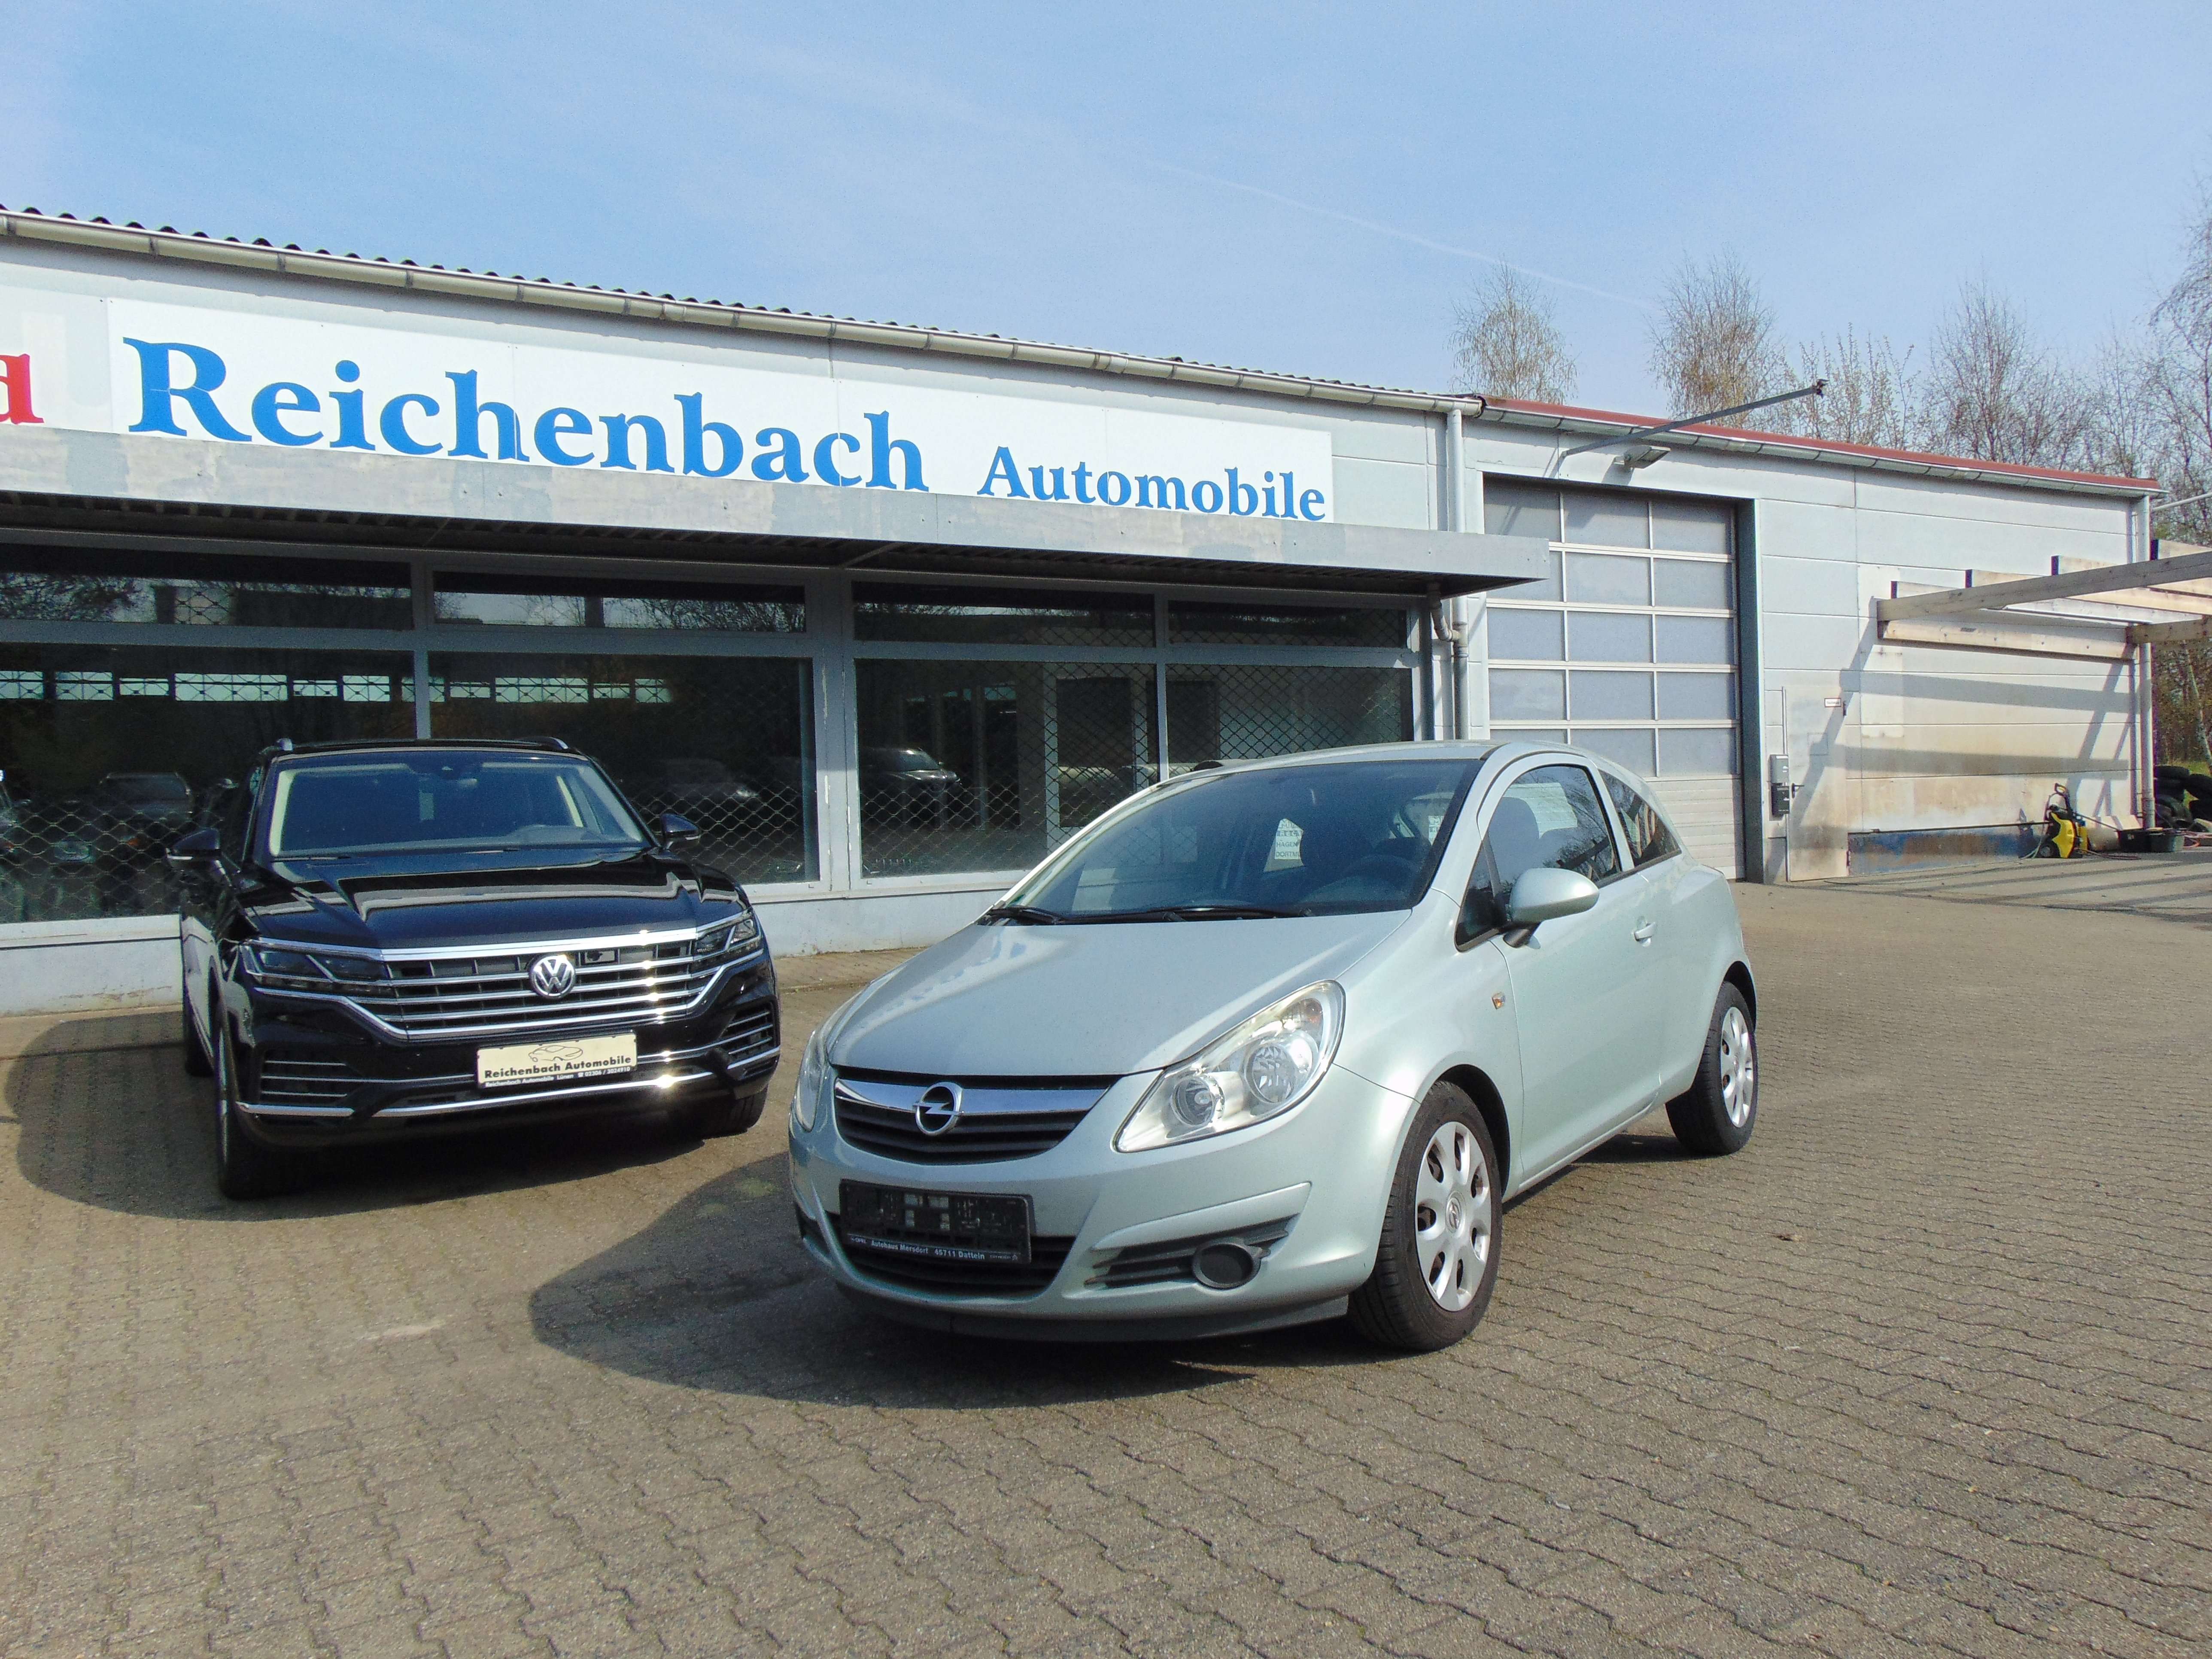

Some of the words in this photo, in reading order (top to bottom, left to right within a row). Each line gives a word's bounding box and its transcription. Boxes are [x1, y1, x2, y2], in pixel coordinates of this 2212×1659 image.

[124, 338, 929, 492] Reichenbach
[978, 446, 1325, 521] Automobile
[484, 1063, 561, 1078] Reichenbach
[565, 1055, 631, 1070] Automobile
[485, 1079, 521, 1087] Reichenbach
[522, 1076, 554, 1084] Automobile
[871, 1240, 899, 1250] Autohaus
[934, 1248, 956, 1257] 45711
[958, 1251, 985, 1260] Datteln
